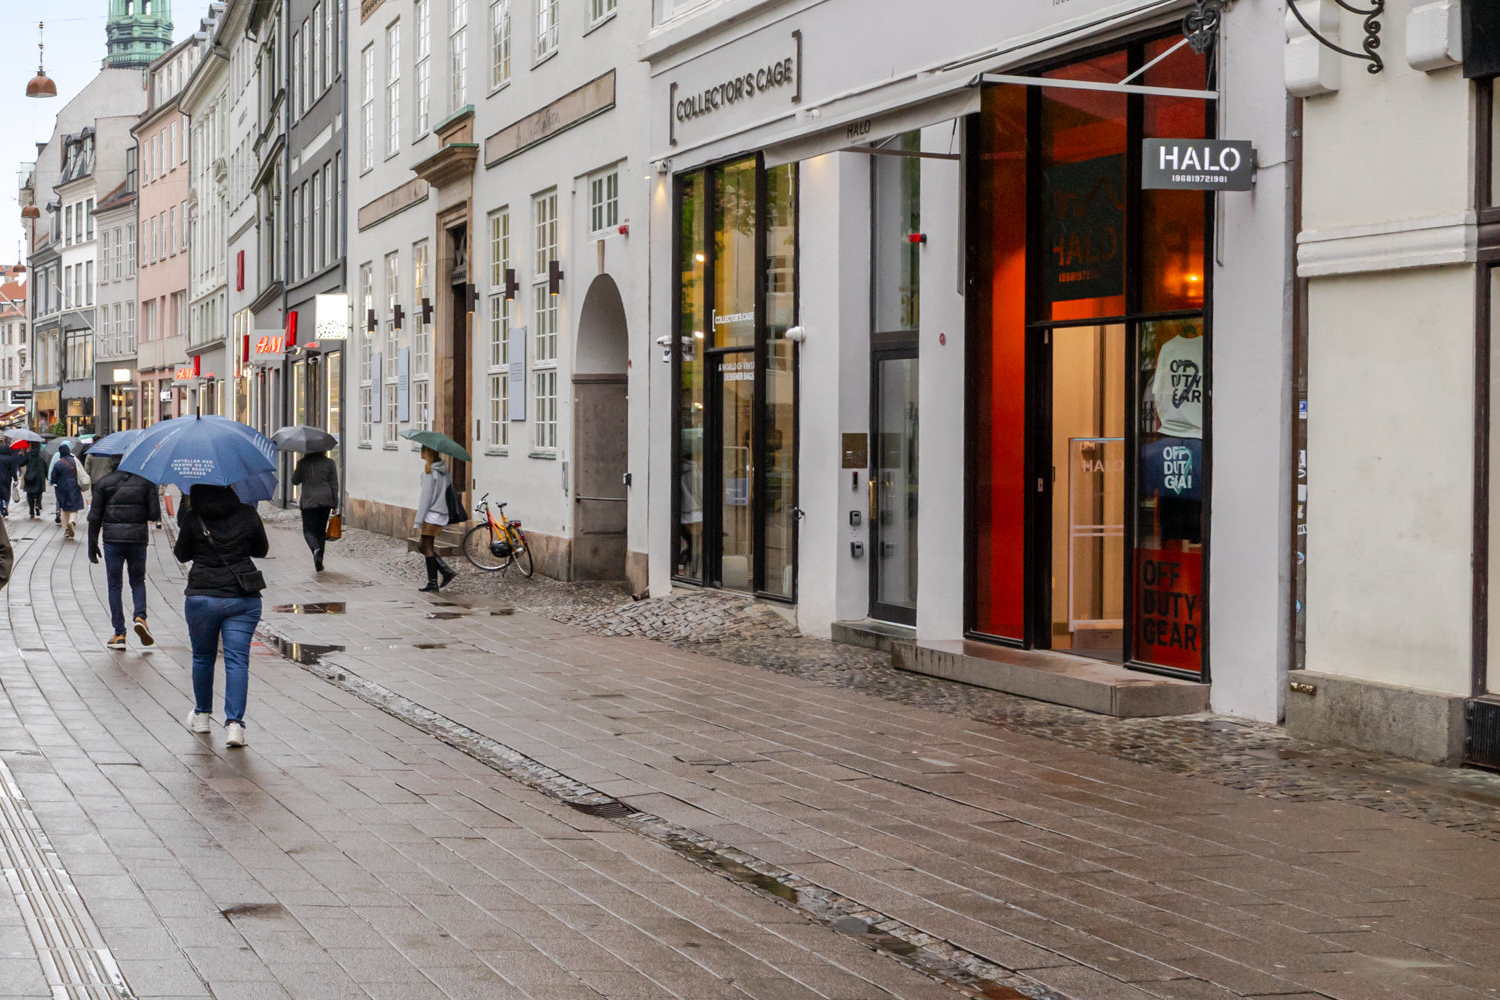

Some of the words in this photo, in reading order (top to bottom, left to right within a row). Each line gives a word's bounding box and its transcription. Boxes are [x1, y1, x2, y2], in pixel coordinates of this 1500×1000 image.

[676, 72, 755, 123] COLLECTOR'S
[756, 57, 793, 93] CAGE
[846, 119, 871, 139] HALO
[1159, 146, 1241, 172] HALO
[1171, 174, 1228, 183] 196819721981
[255, 335, 283, 354] H&M
[176, 367, 194, 380] H&M
[1143, 559, 1181, 589] OFF
[1143, 588, 1197, 621] DUTY
[1143, 617, 1198, 652] GEAR
